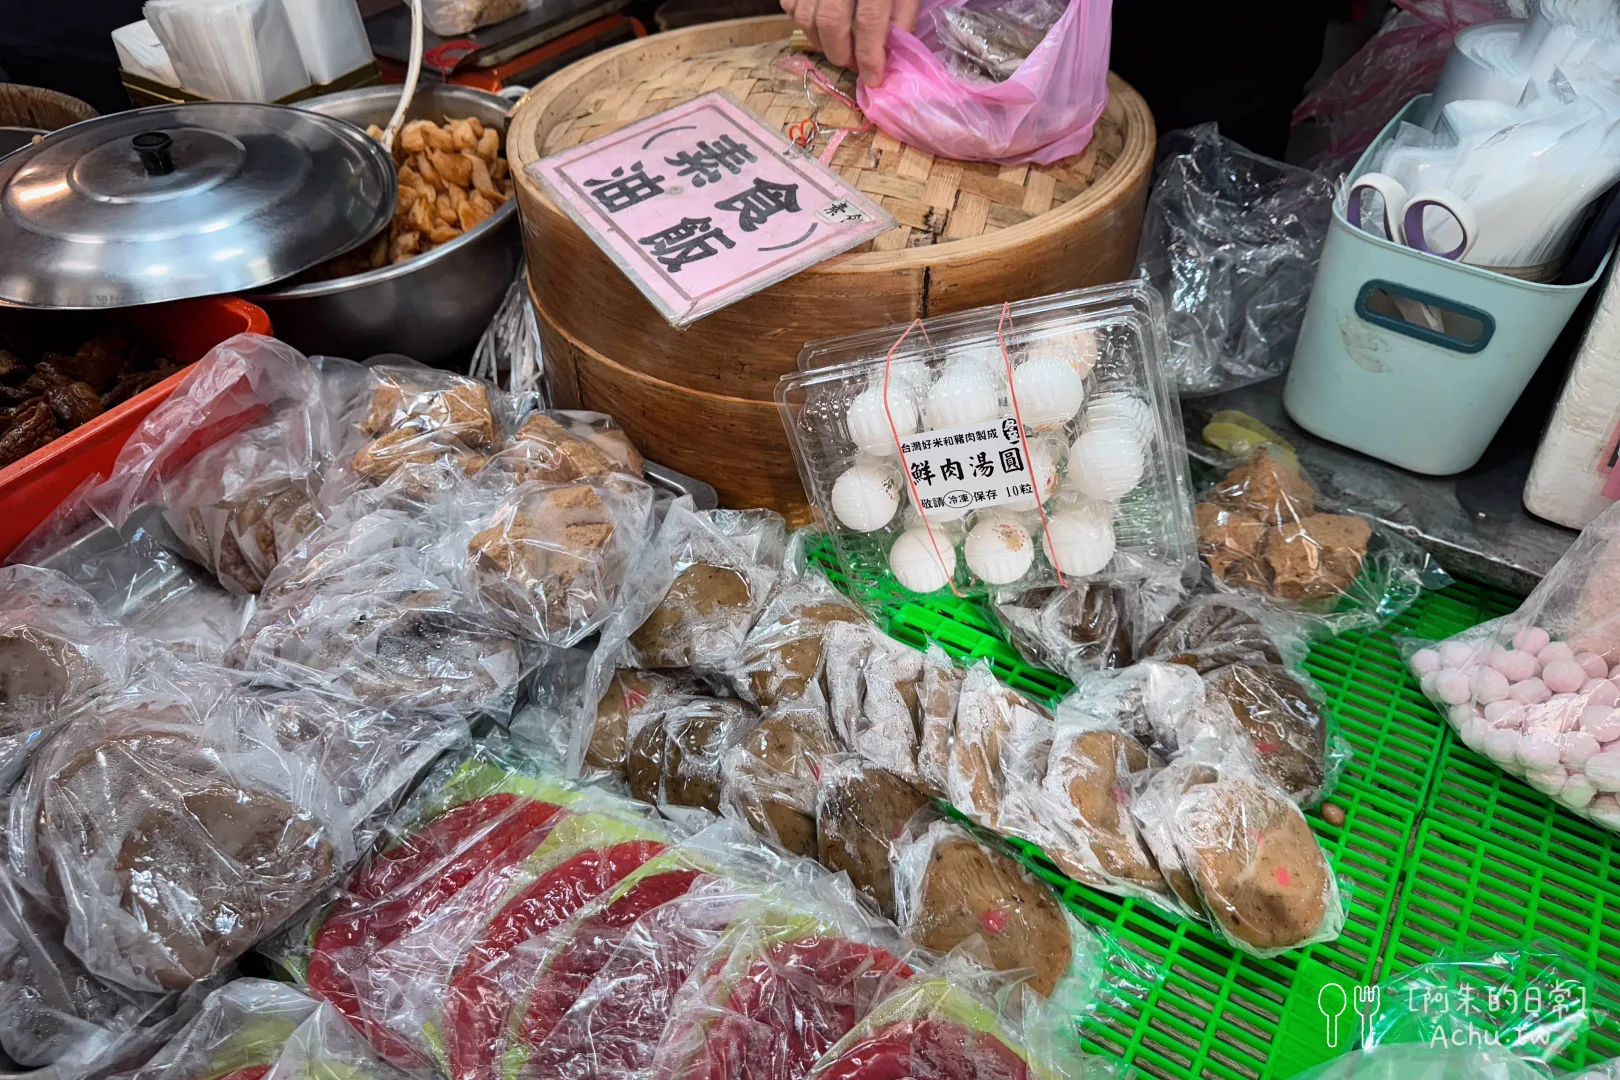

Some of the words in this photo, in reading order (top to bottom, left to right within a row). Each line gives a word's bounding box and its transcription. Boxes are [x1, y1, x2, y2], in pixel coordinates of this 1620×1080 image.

[582, 160, 737, 273] 油飯
[901, 428, 999, 454] 台灣好米和豬肉製成
[910, 447, 1025, 487] 鮮肉湯圓
[1005, 484, 1034, 498] 10粒
